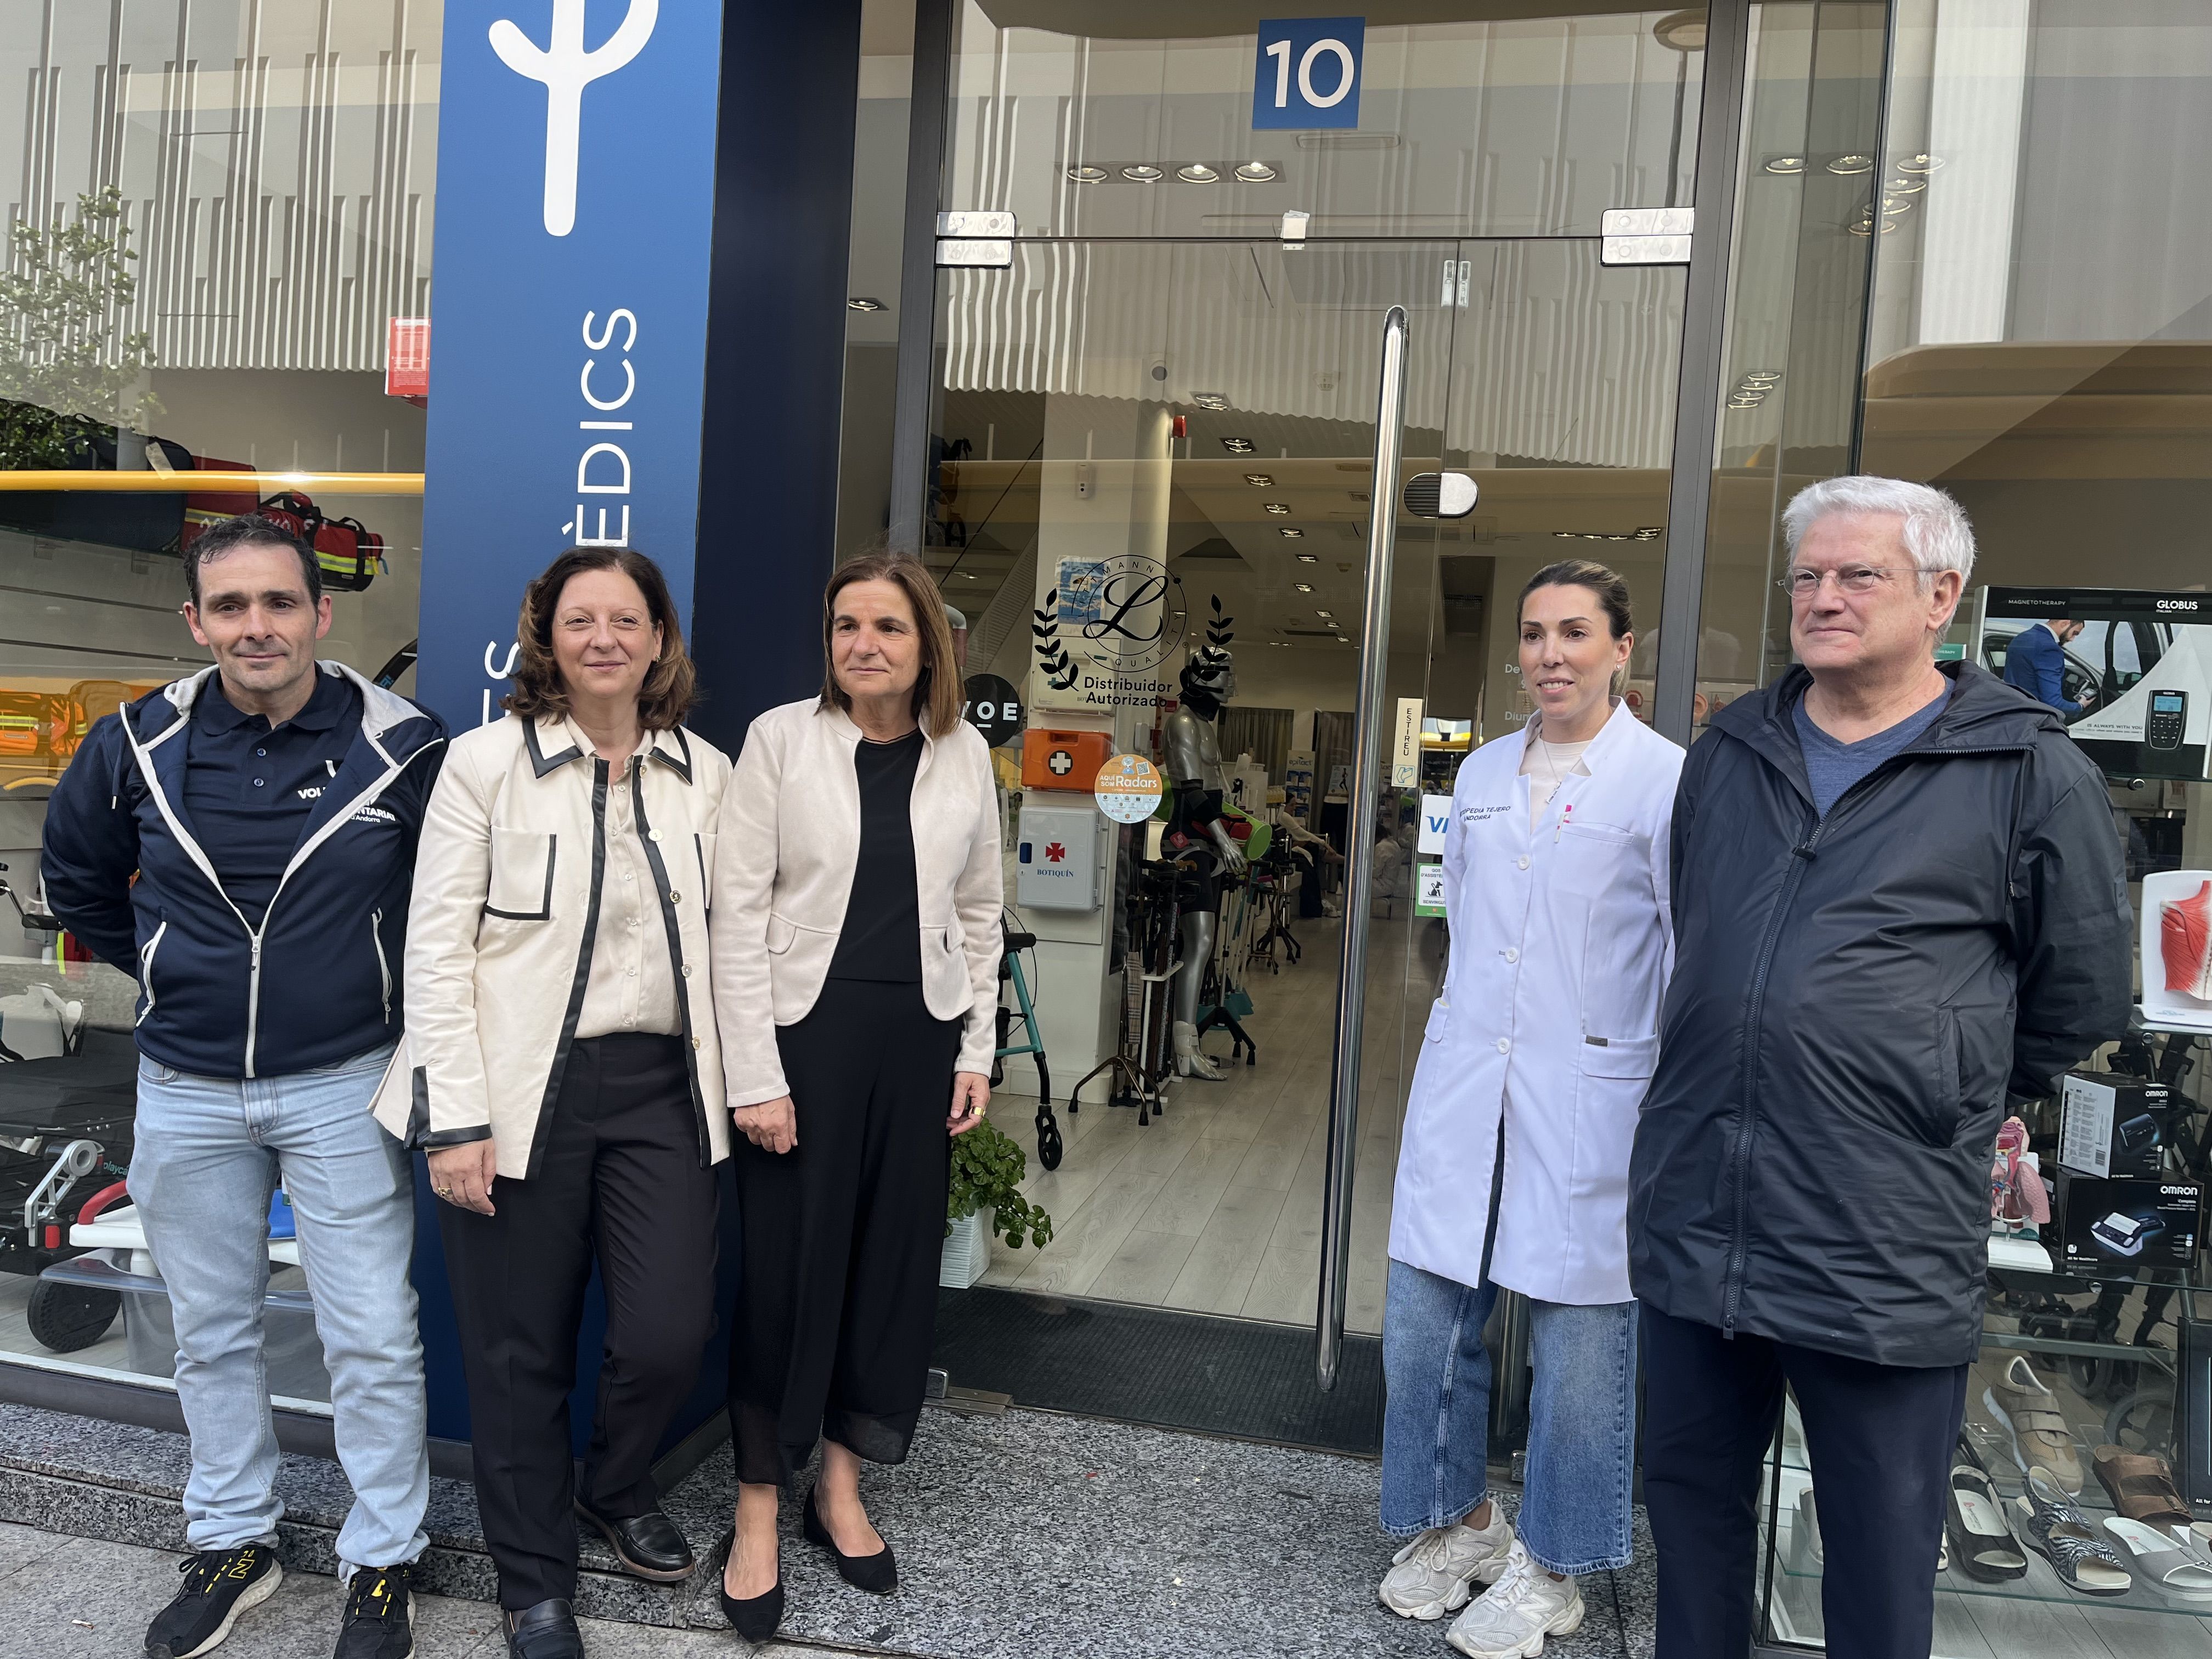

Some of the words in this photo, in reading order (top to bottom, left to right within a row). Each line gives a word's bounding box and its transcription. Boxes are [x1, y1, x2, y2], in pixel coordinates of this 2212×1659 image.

[1266, 38, 1355, 108] 10
[561, 308, 637, 547] ÈDICS
[1078, 561, 1154, 617] LITTMANN
[2157, 600, 2198, 610] GLOBUS
[1115, 615, 1181, 667] QUALITY
[1085, 676, 1173, 692] Distribuidor
[1086, 691, 1167, 707] Autorizado
[1404, 708, 1413, 756] ESTIREU
[1116, 775, 1157, 788] Radars
[297, 787, 326, 799] VOL
[351, 815, 381, 823] d'Andorra
[357, 806, 396, 821] NTARIAT
[1425, 815, 1449, 833] VI
[1037, 869, 1074, 878] BOTIQUÍN
[2160, 1186, 2198, 1195] OMRON
